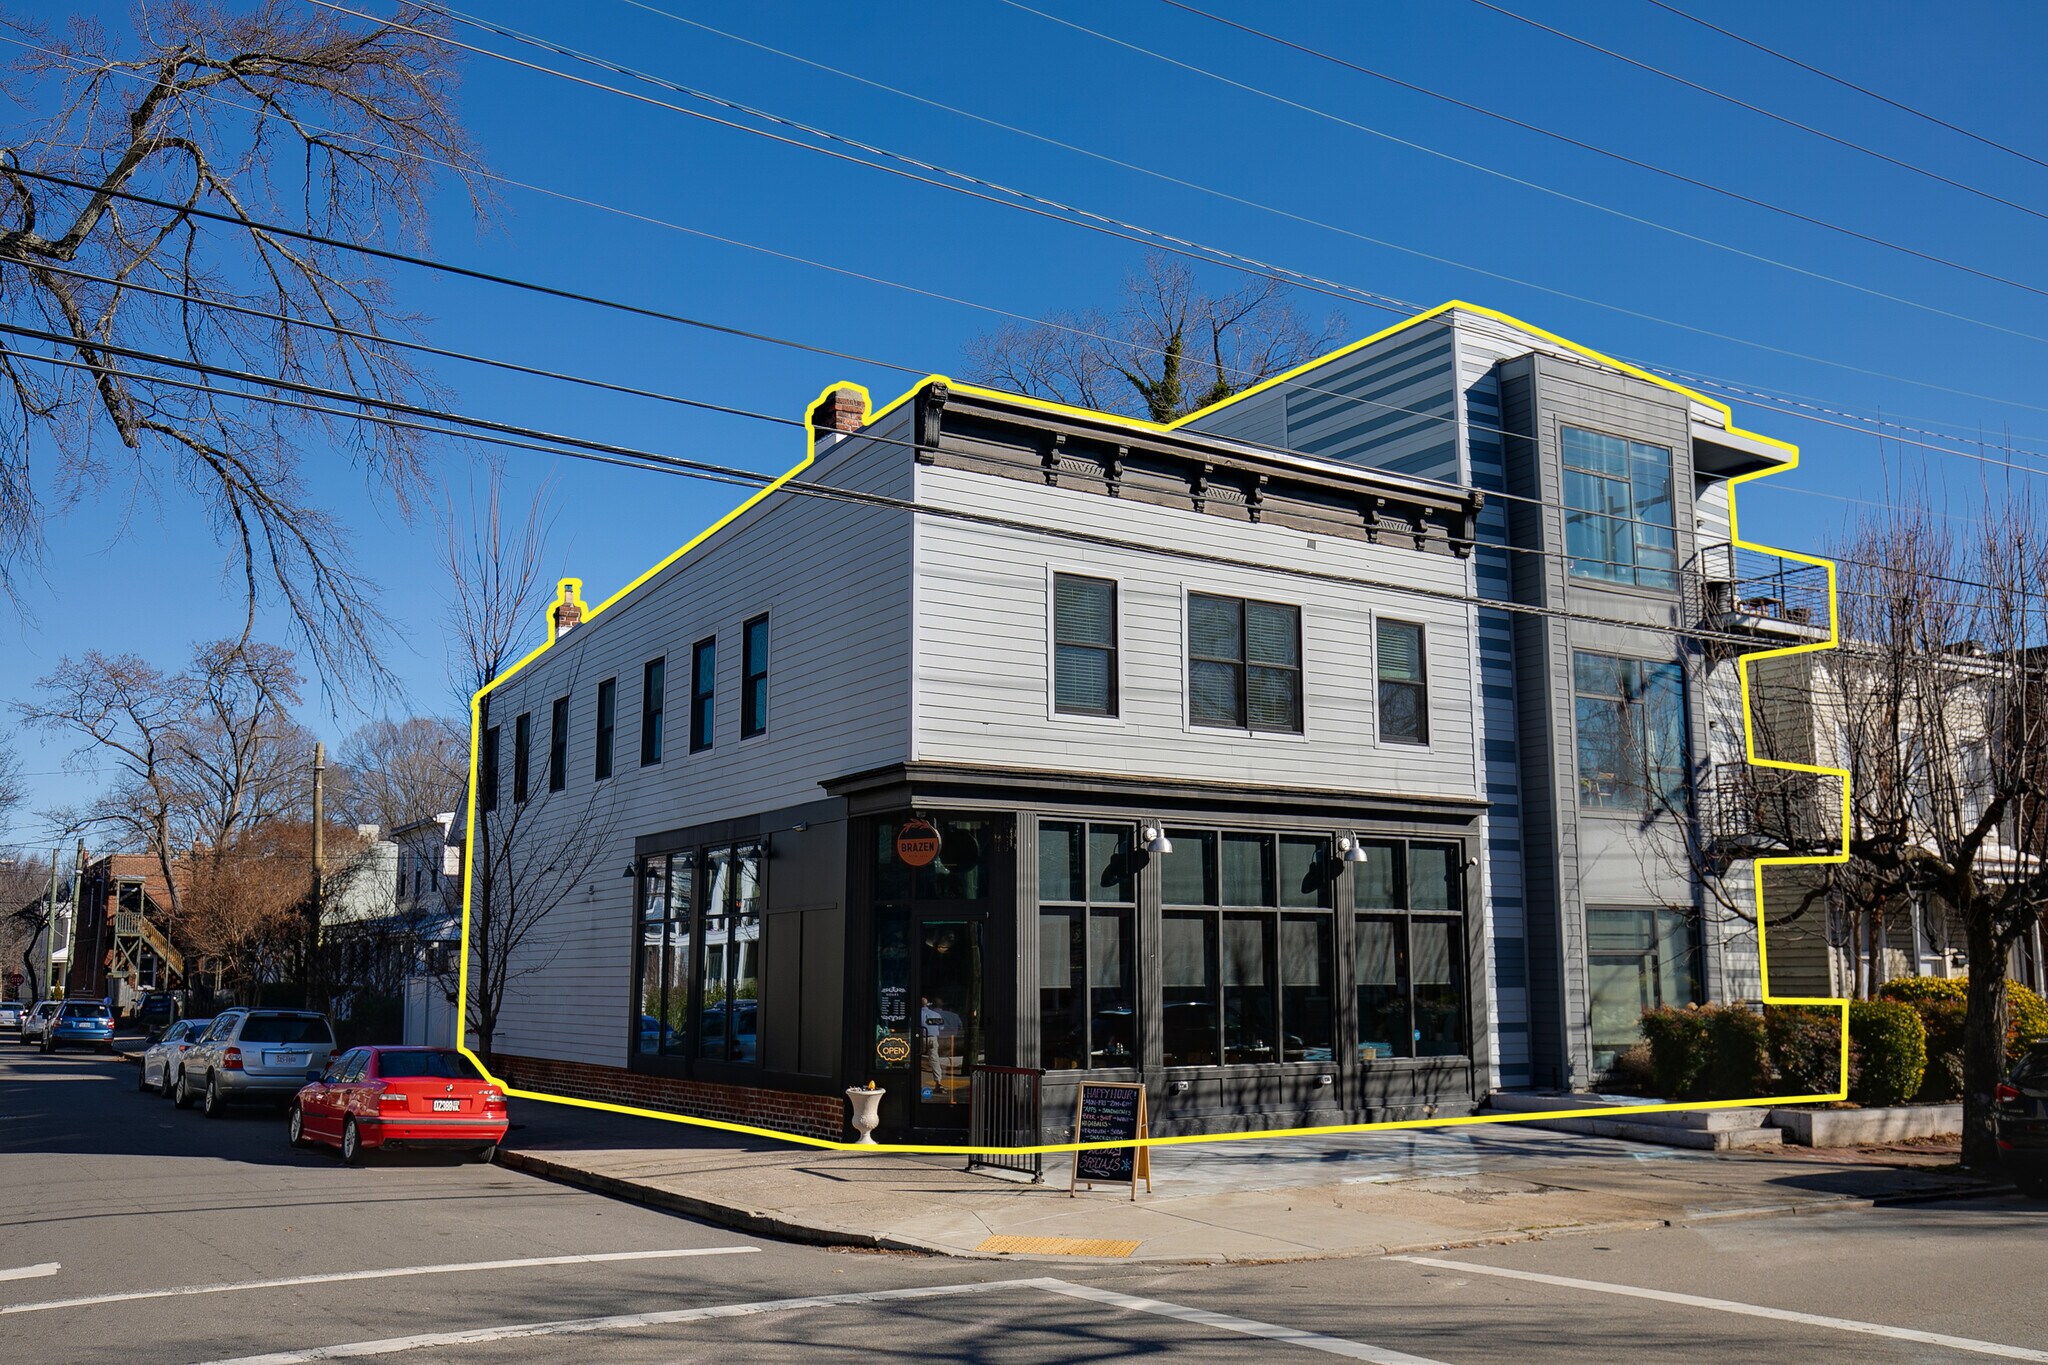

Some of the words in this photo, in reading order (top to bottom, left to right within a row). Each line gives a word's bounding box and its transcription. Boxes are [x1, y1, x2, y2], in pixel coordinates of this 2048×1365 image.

[902, 842, 934, 852] BRAZEN
[882, 1046, 905, 1055] OPEN
[1080, 1156, 1120, 1171] SPECIALS
